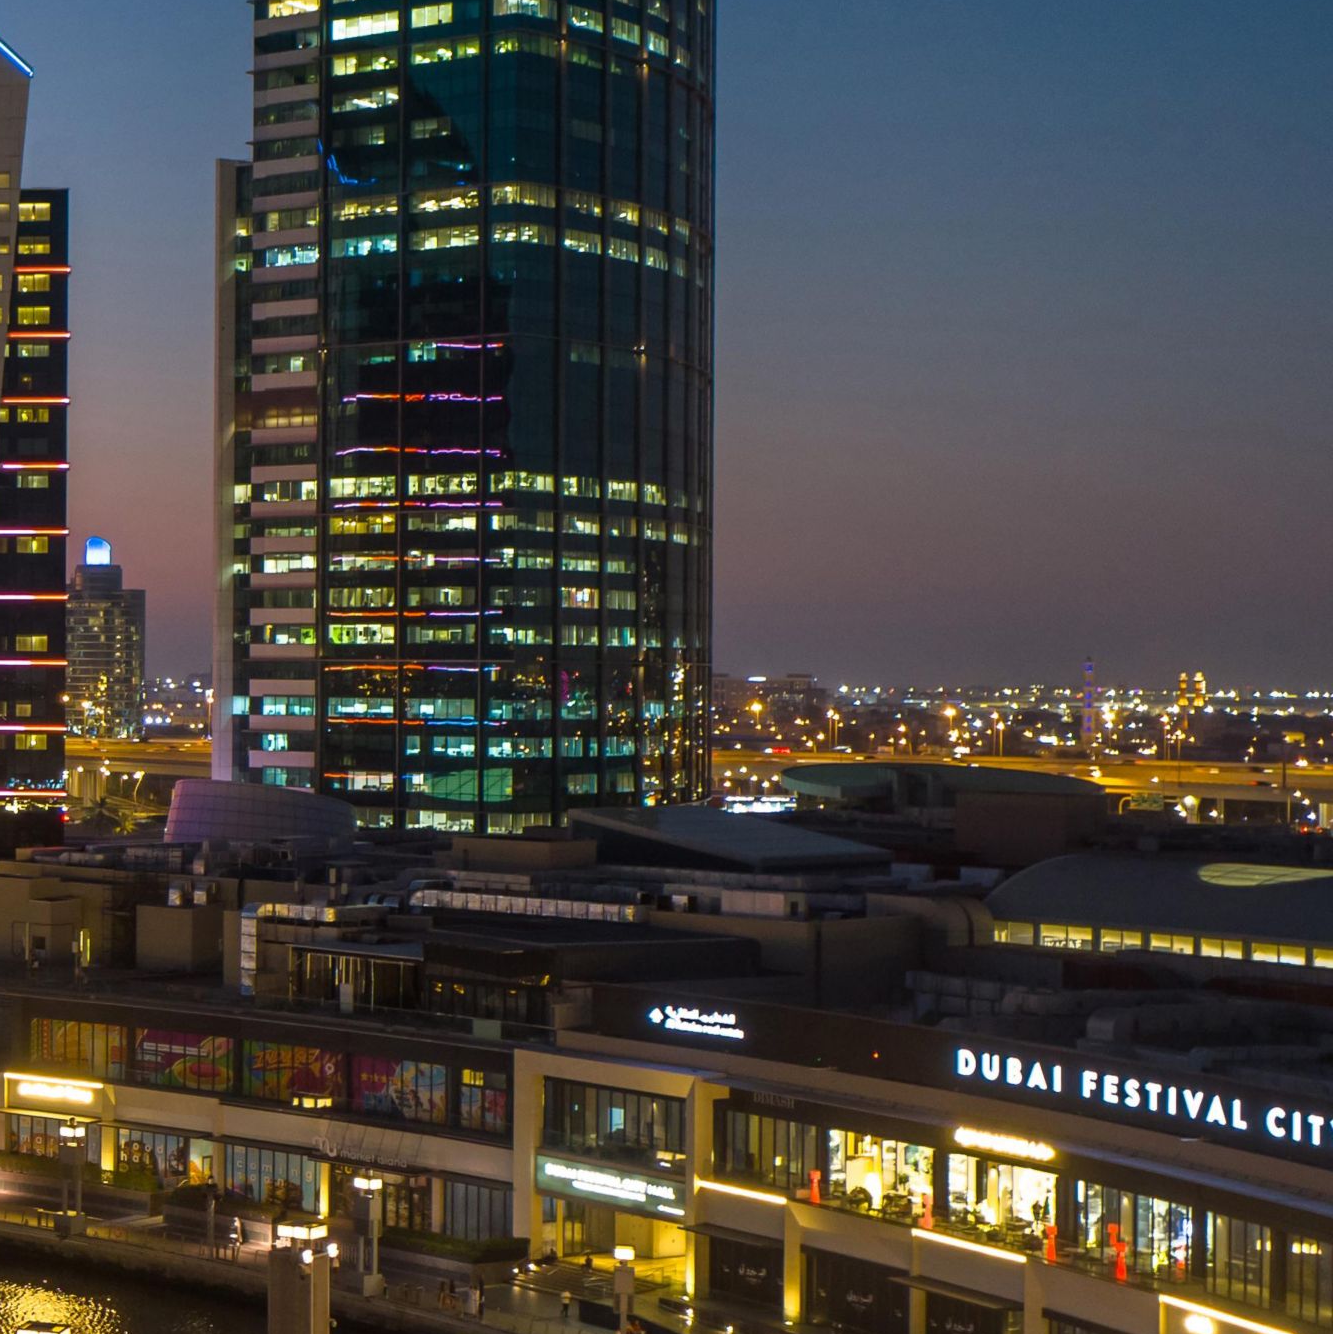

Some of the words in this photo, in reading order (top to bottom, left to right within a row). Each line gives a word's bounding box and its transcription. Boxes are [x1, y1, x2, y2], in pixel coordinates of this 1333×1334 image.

[955, 1047, 1062, 1093] DUBAI
[1081, 1069, 1248, 1131] FESTIVAL
[1265, 1106, 1333, 1146] CIT
